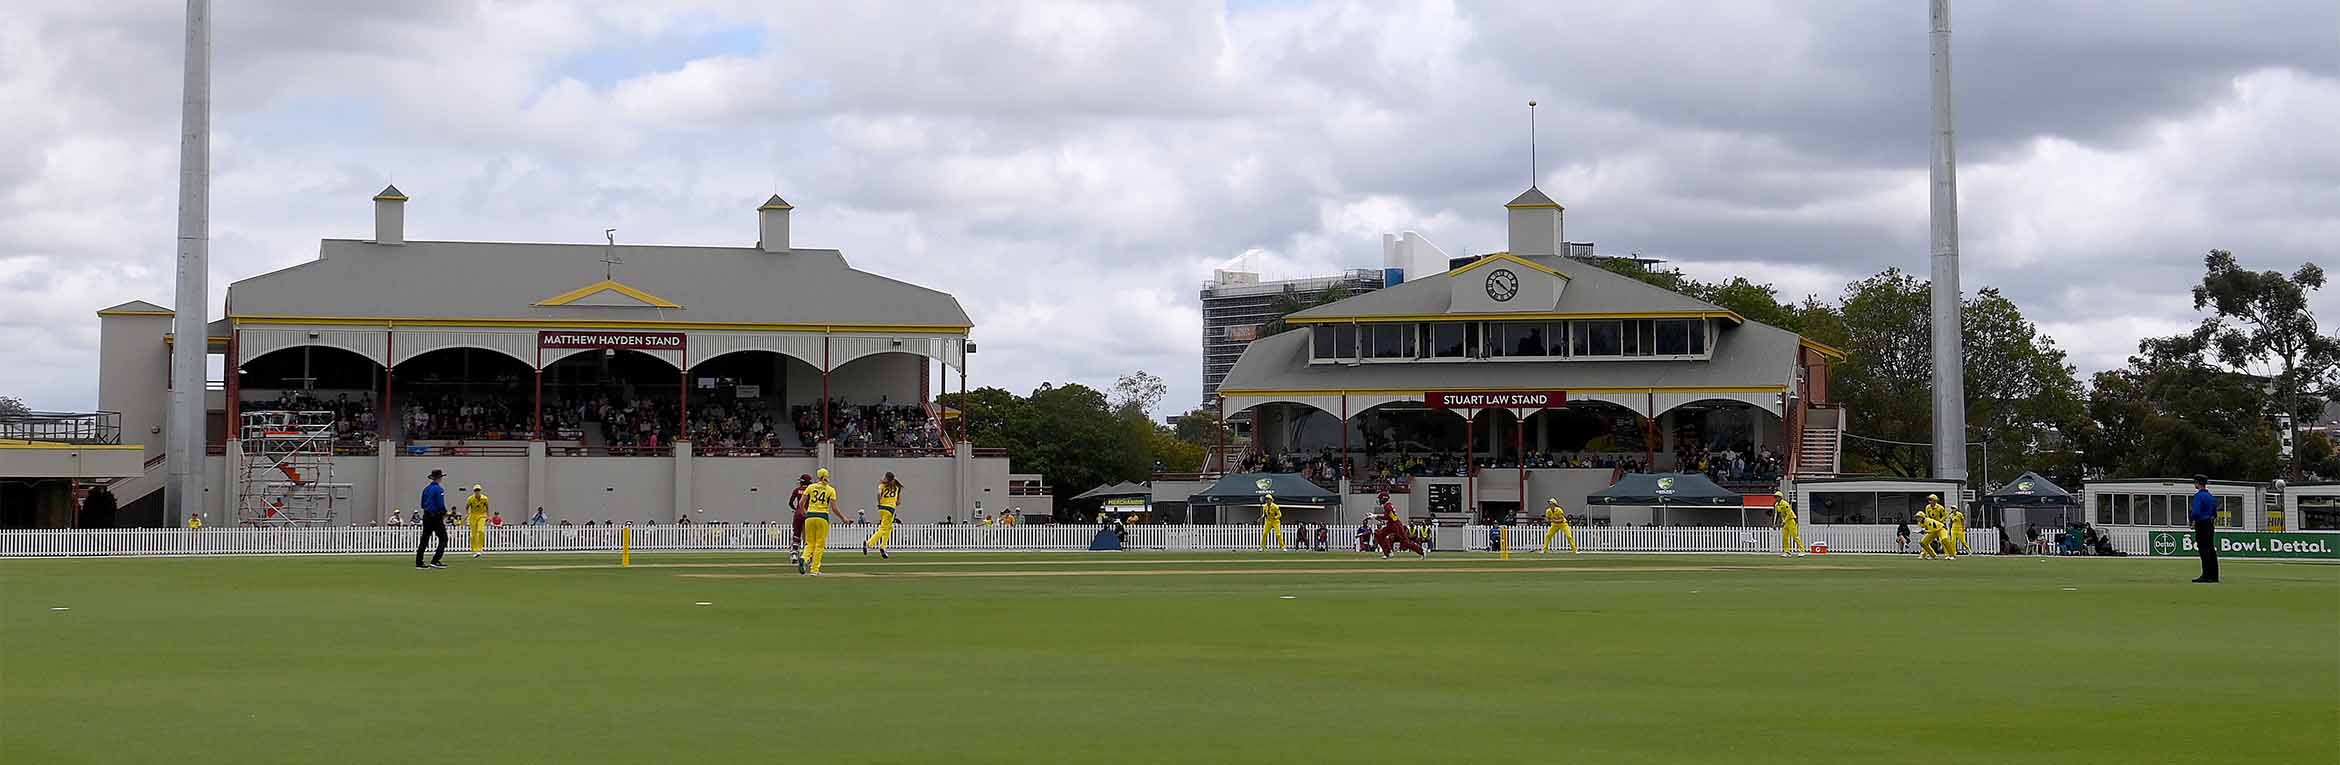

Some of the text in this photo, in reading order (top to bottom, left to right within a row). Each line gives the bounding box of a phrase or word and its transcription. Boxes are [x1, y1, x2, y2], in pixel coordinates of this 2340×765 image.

[544, 335, 681, 346] MATTHEW HAYDEN STAND
[1443, 394, 1548, 405] STUART LAW STAND
[811, 489, 826, 504] 34
[2220, 538, 2267, 552] Bowl.
[2270, 538, 2332, 553] Dettol.
